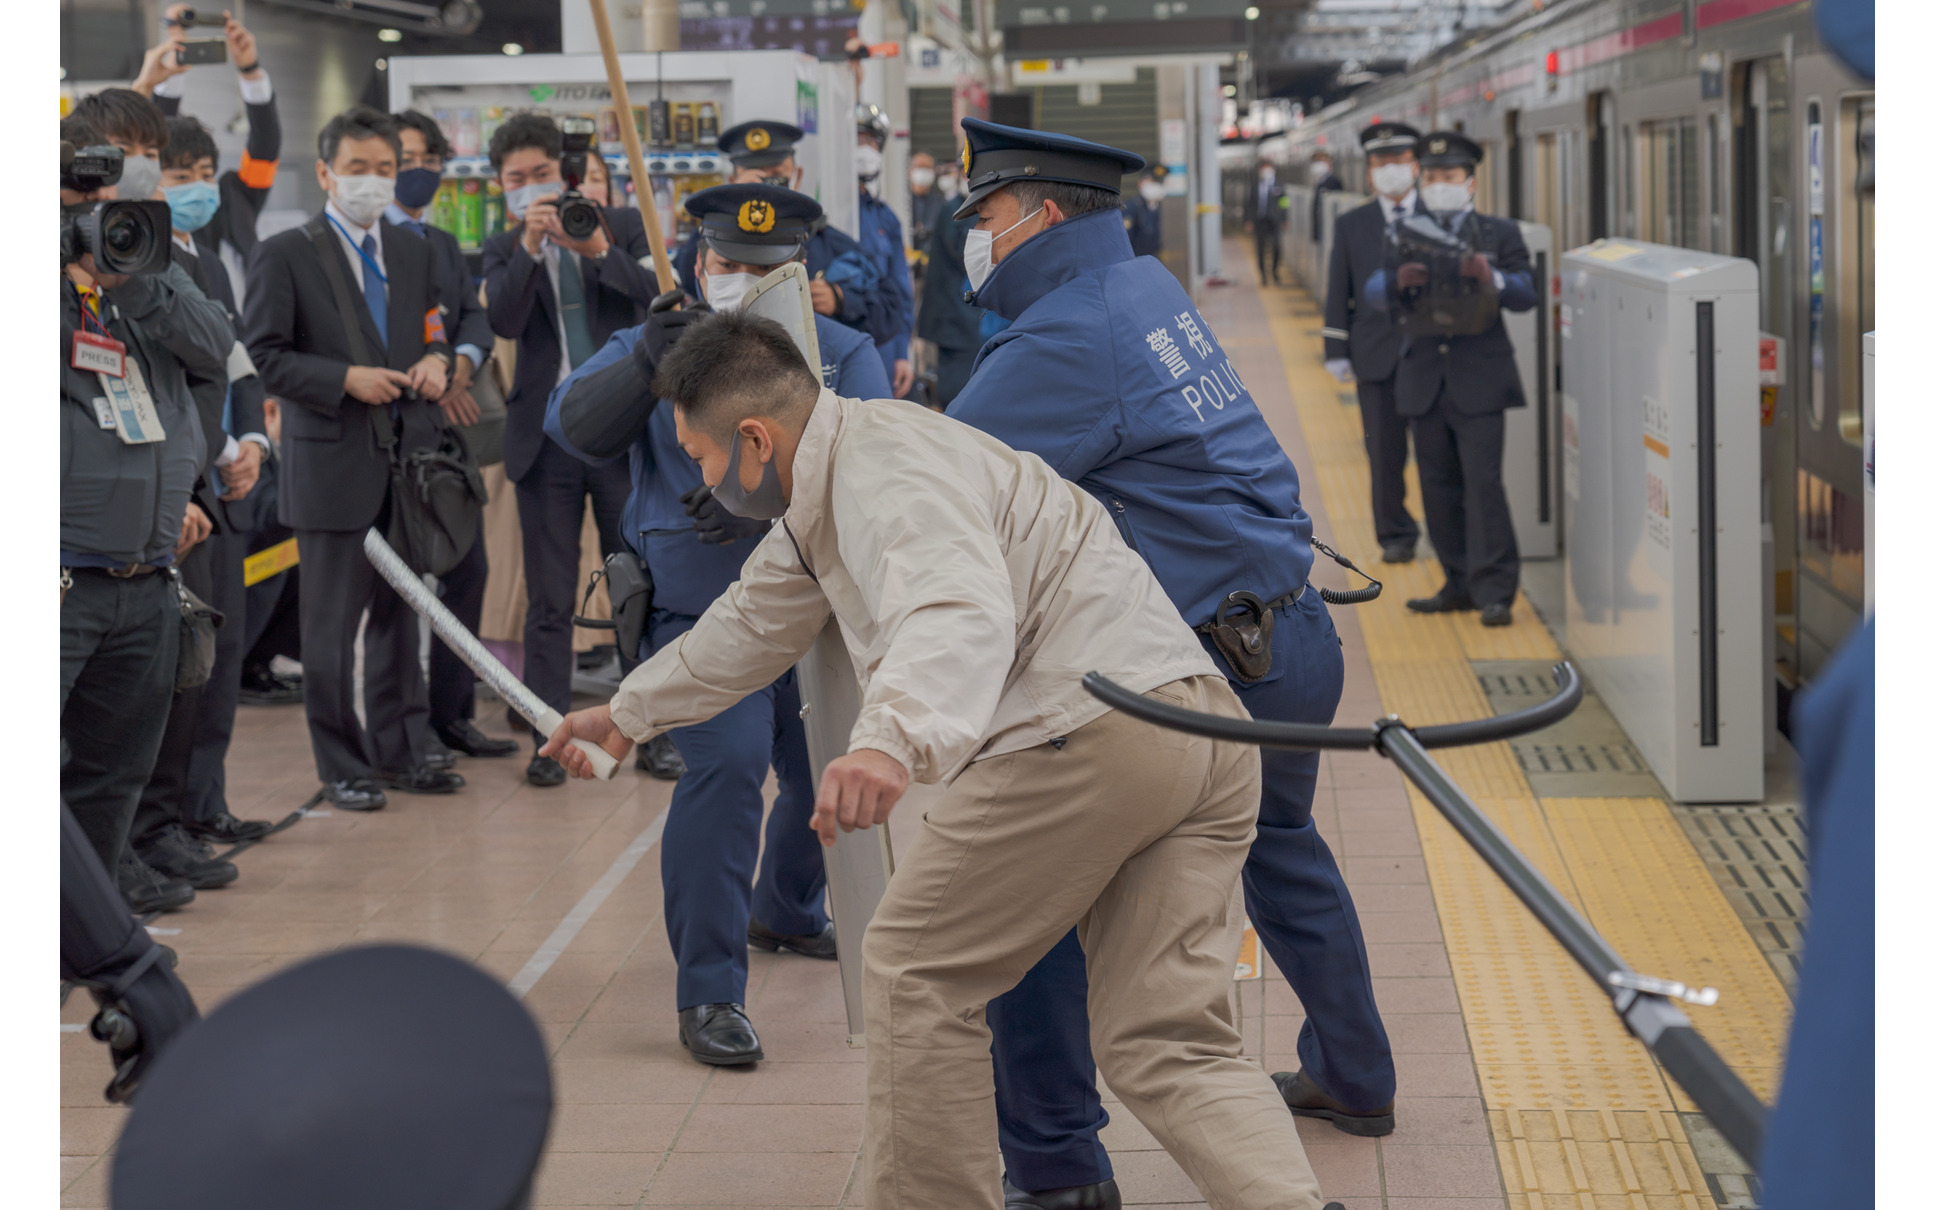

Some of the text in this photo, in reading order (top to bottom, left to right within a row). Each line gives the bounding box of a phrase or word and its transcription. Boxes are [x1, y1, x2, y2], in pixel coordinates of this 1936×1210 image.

[555, 86, 586, 100] ITO
[1145, 309, 1220, 380] 警視
[81, 350, 117, 368] PRESS
